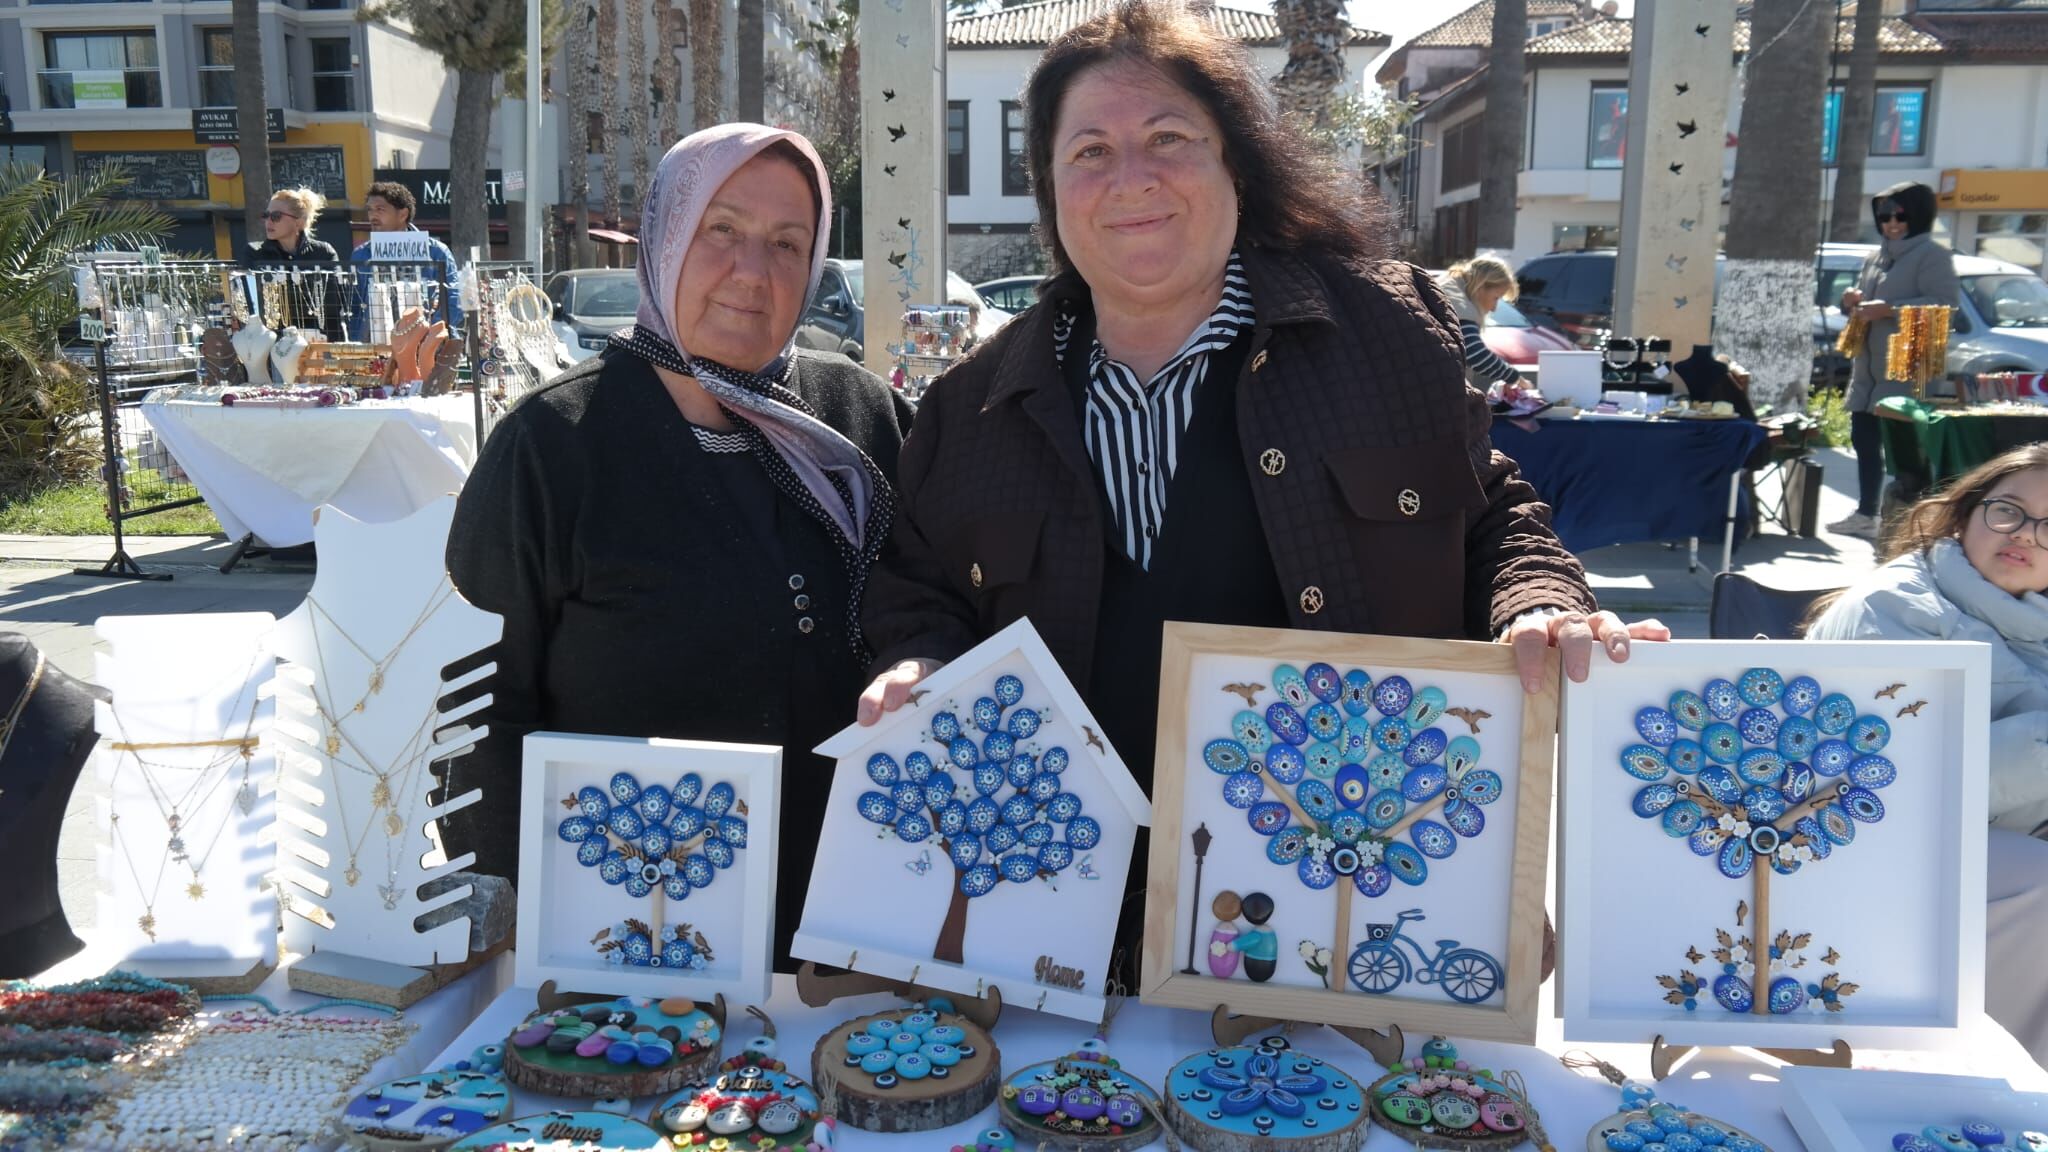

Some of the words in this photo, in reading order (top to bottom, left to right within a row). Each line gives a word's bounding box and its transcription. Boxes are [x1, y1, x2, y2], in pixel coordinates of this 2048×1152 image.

[201, 113, 228, 121] AVUKAT
[125, 154, 157, 165] Morning
[144, 249, 160, 265] 400
[82, 323, 104, 339] 200
[1034, 954, 1086, 990] Home
[716, 1074, 773, 1092] Home
[542, 1120, 603, 1142] Home
